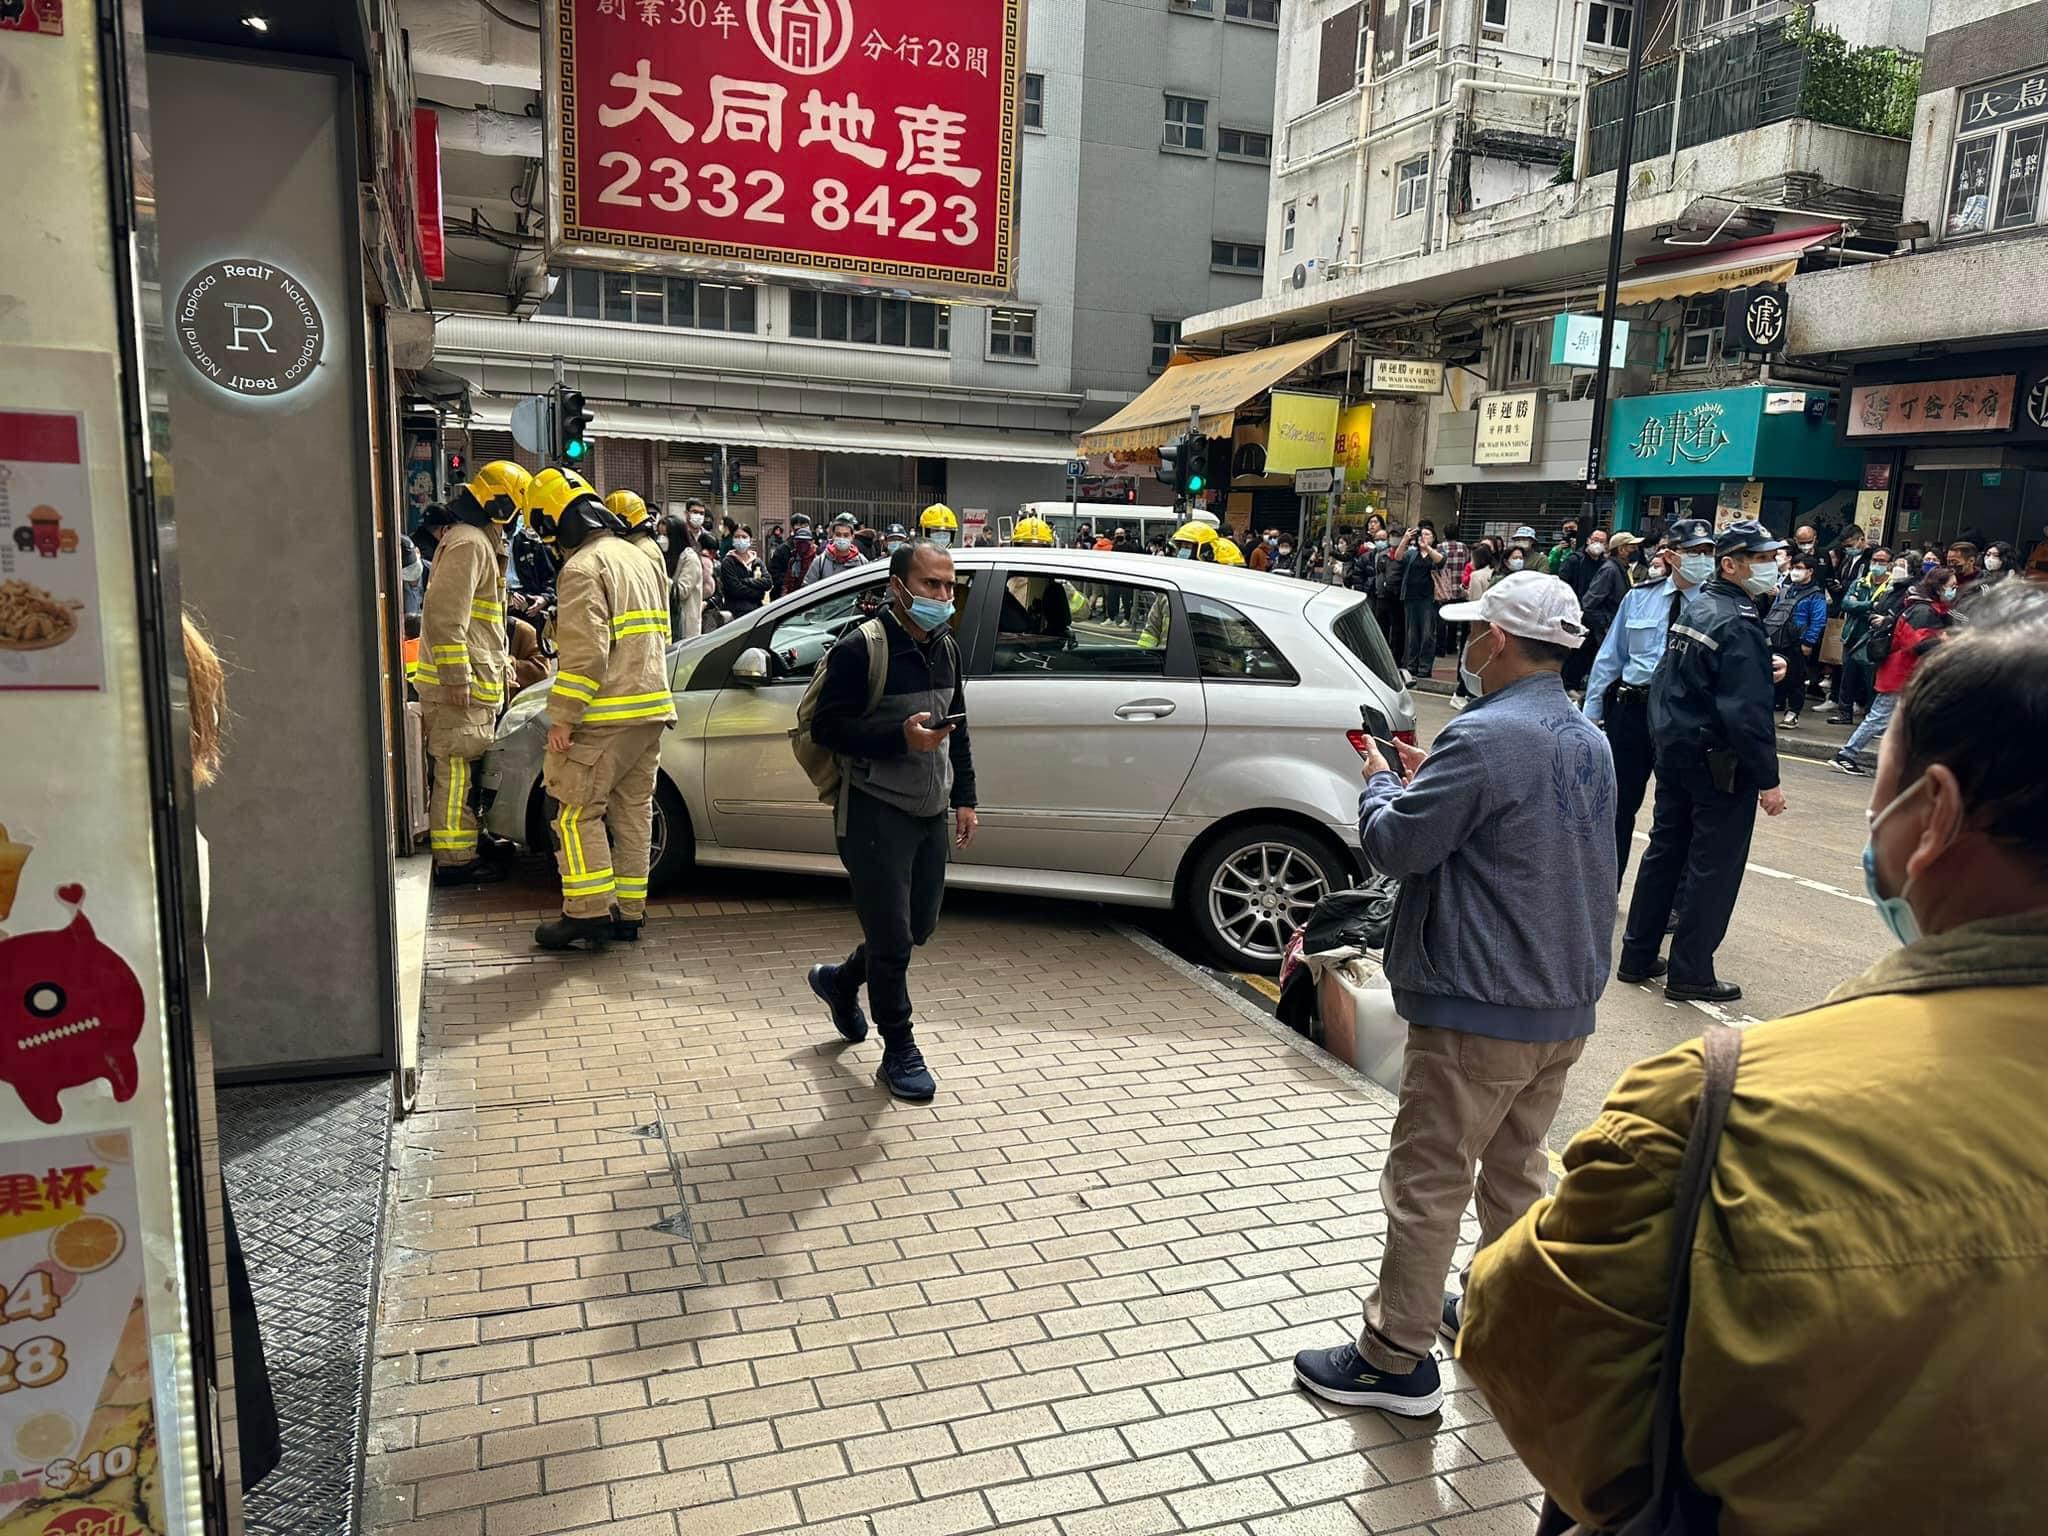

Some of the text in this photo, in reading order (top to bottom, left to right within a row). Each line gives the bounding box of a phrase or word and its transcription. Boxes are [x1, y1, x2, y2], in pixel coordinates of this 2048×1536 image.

[861, 28, 989, 79] 分行28間
[598, 58, 983, 188] 大同地產
[597, 151, 980, 247] 2332 8423
[222, 265, 274, 281] RealT
[181, 275, 222, 377] Natural Tapioca
[280, 279, 320, 380] Natural Tapioca
[227, 375, 279, 390] RealT
[1487, 400, 1528, 420] 華運勝
[45, 1445, 137, 1490] $10
